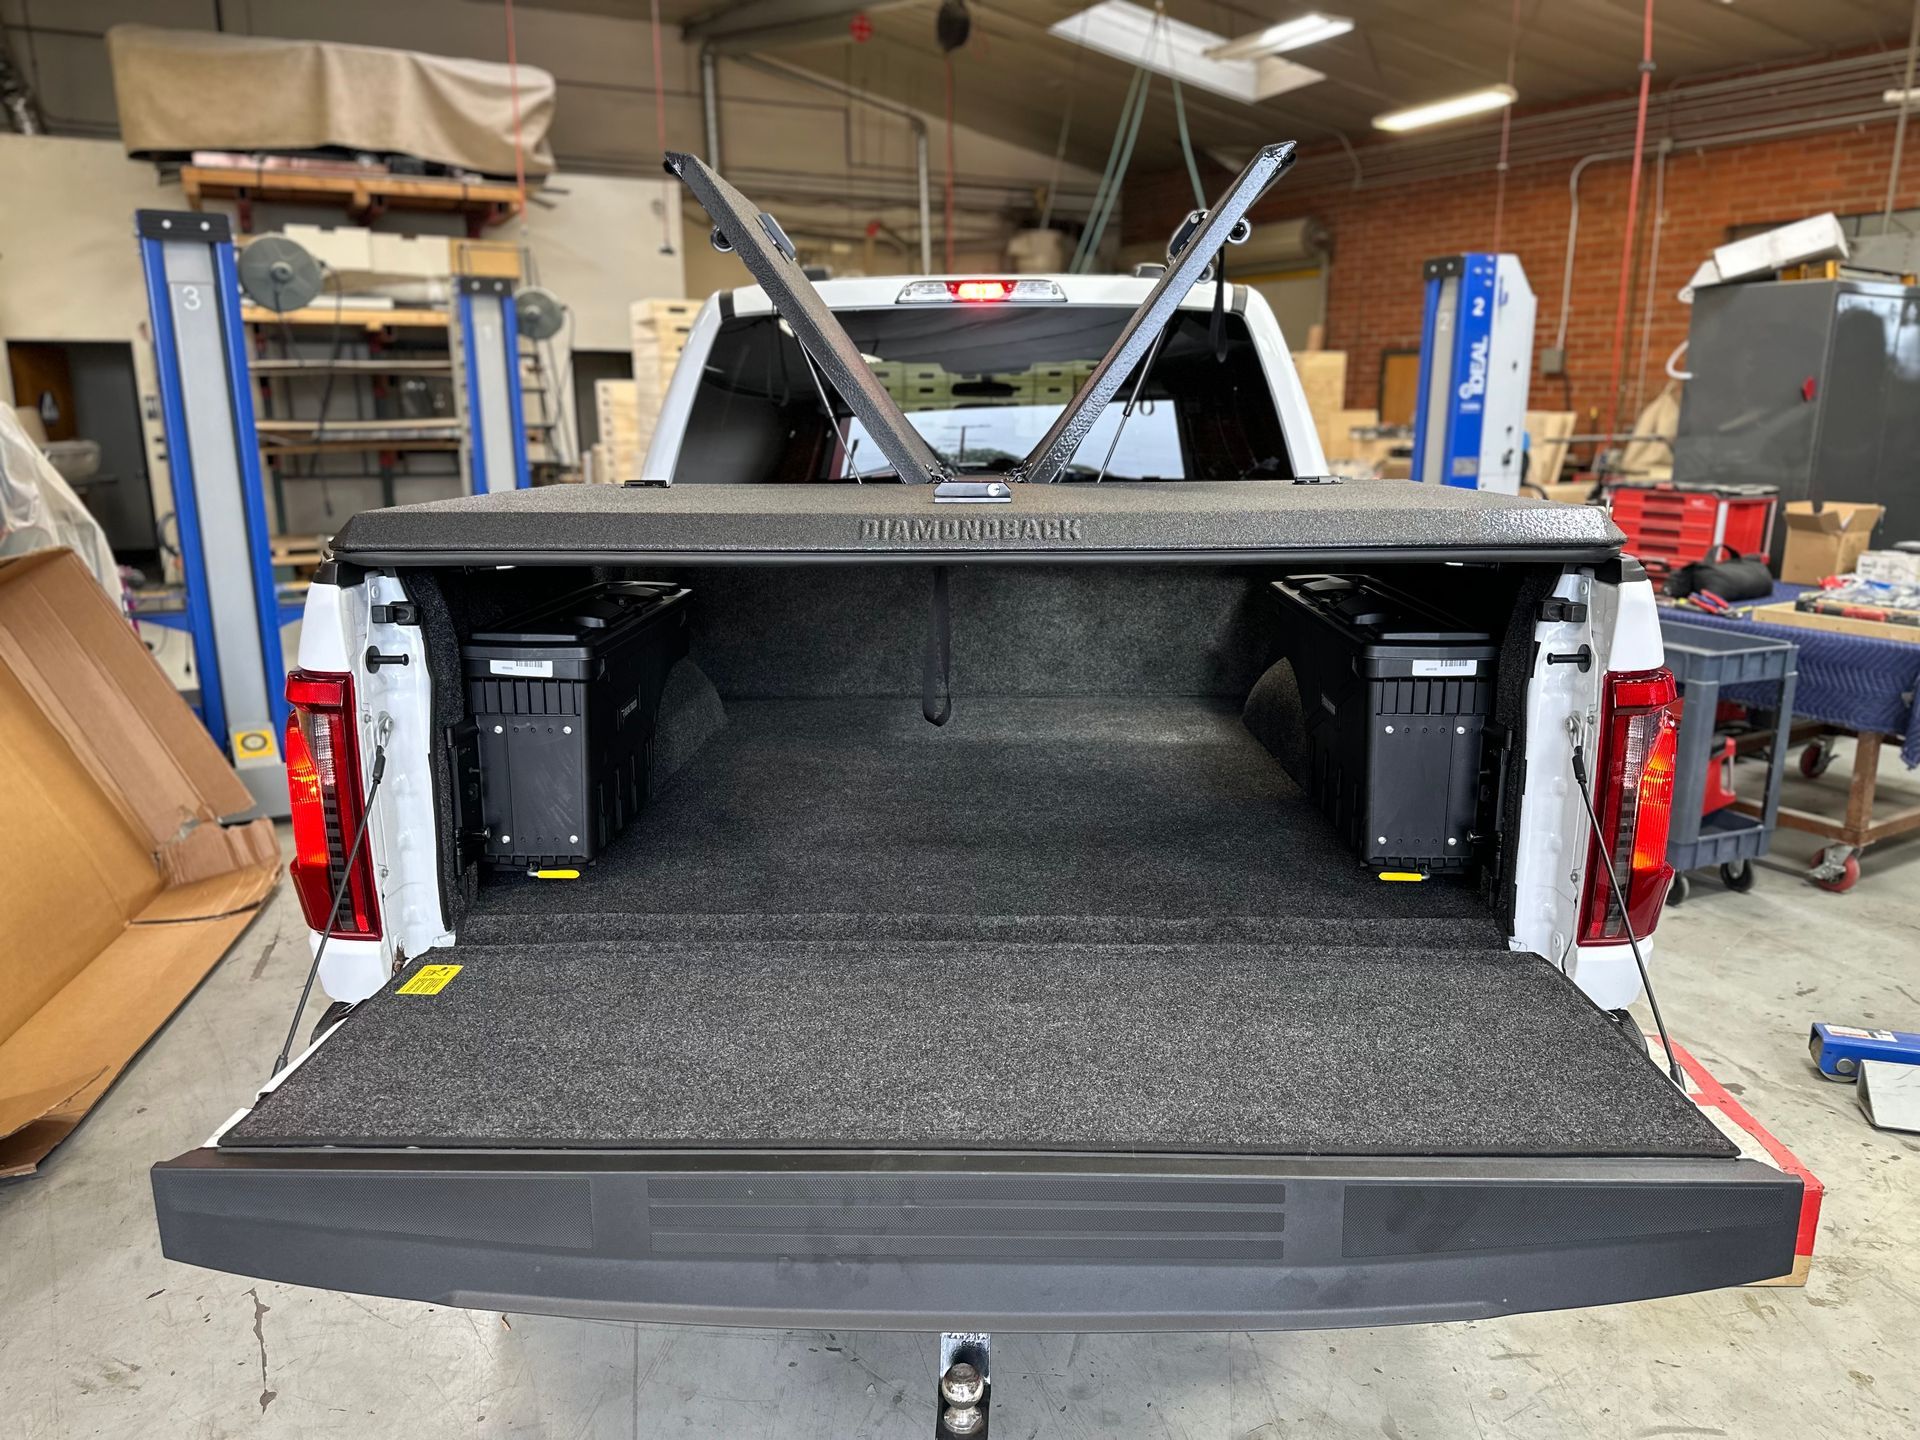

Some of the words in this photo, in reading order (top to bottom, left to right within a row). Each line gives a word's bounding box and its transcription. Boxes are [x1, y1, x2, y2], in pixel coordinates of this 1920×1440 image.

[182, 285, 201, 311] 3
[1472, 296, 1486, 317] 2
[1439, 311, 1450, 331] 2
[858, 518, 1082, 542] DIAMONDBACK
